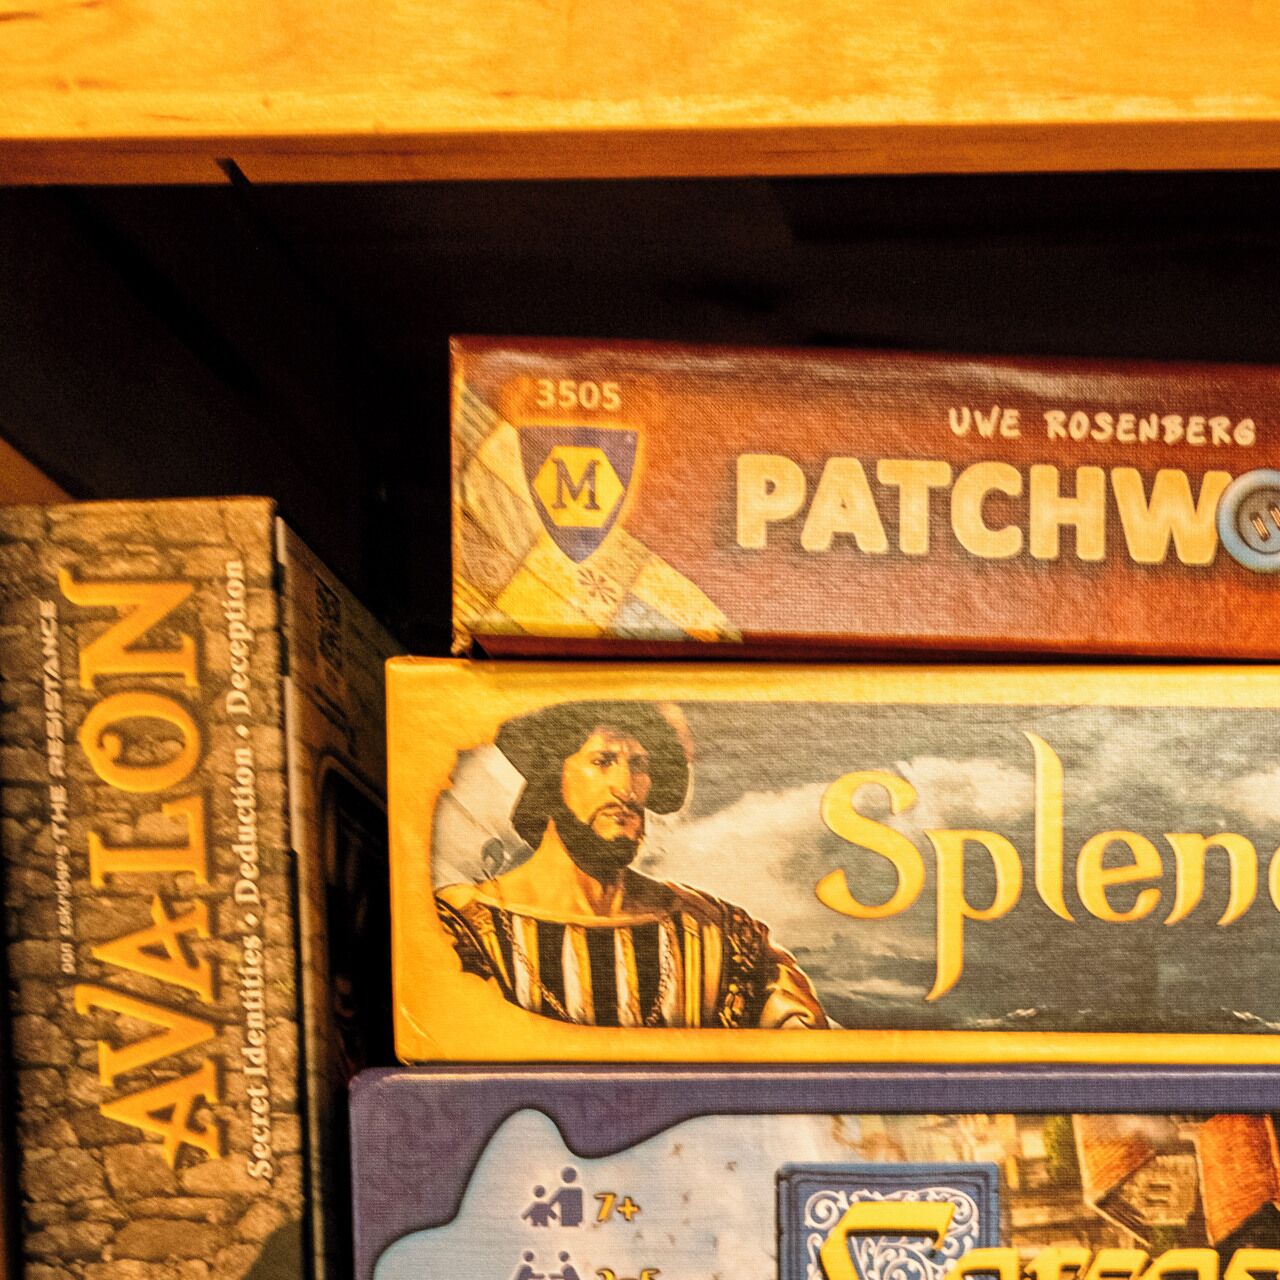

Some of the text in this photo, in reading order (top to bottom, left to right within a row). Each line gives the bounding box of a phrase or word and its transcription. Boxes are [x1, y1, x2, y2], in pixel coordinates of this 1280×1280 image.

[536, 378, 622, 411] 3505
[948, 404, 1257, 447] UWE ROSENBERG
[551, 456, 600, 511] M
[38, 599, 67, 778] RESISTANCE
[48, 785, 69, 842] THE
[59, 566, 221, 1169] AVALON
[222, 560, 275, 1181] Secret Identities Deduction Deception
[592, 1191, 640, 1224] 7+
